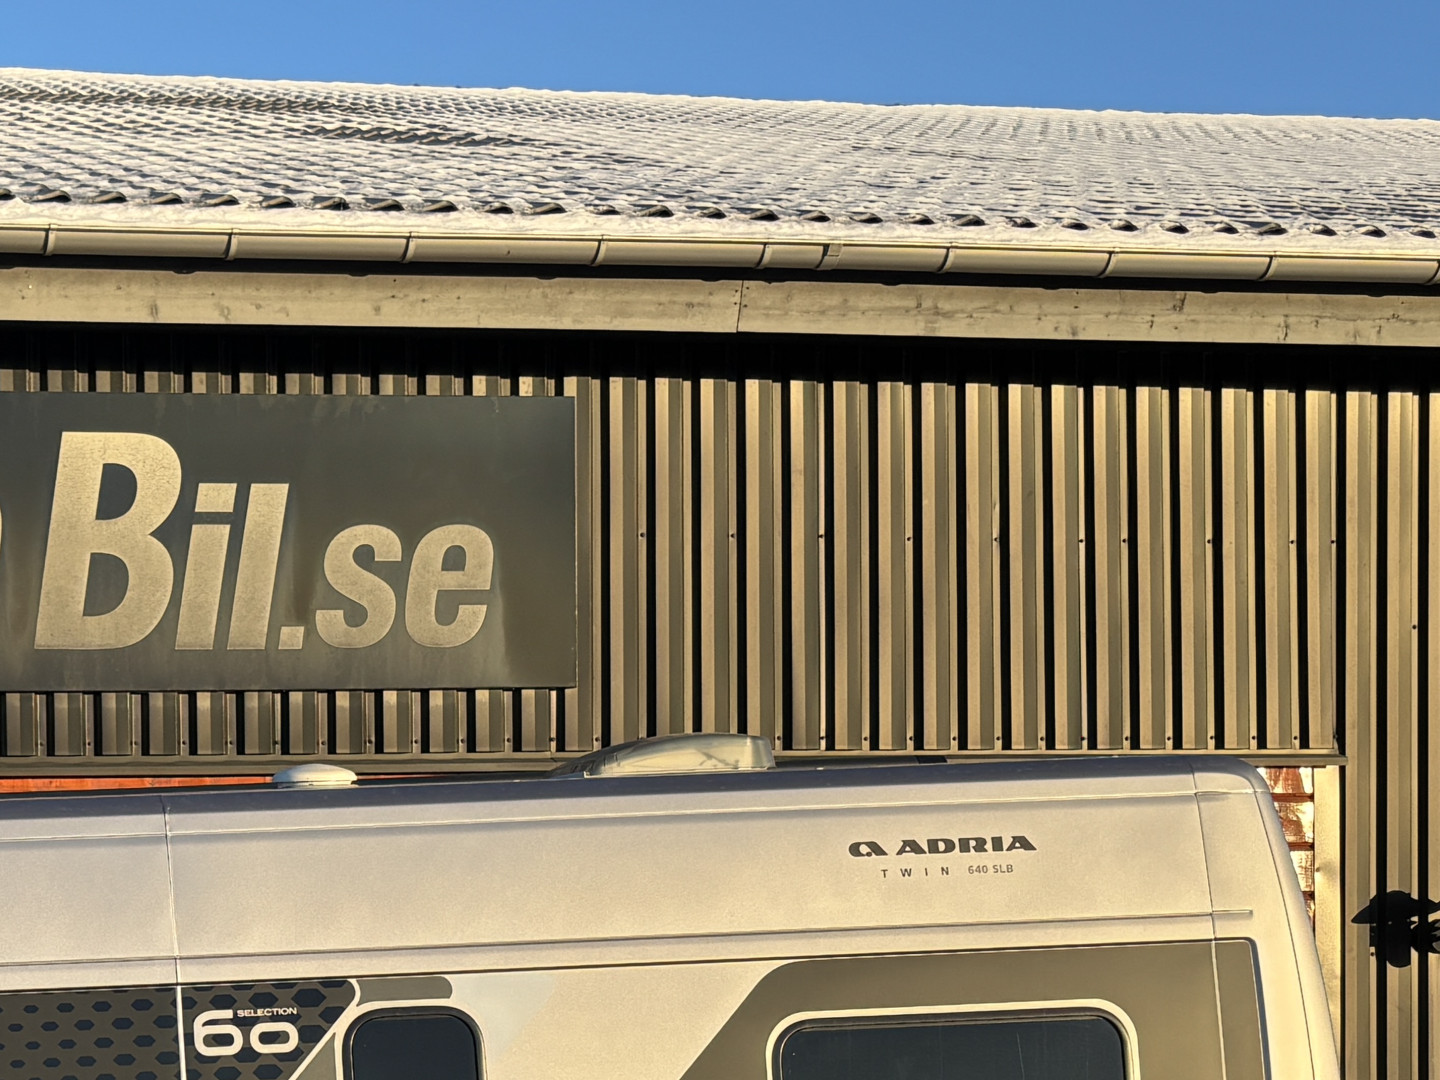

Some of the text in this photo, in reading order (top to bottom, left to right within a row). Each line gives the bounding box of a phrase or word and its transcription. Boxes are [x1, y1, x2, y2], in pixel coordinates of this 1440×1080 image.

[33, 430, 495, 651] Bil.se
[896, 835, 1038, 856] ADRIA
[880, 863, 1014, 878] TWIN 640 SLB
[236, 1006, 298, 1018] SELECTION
[193, 1009, 299, 1057] 60
